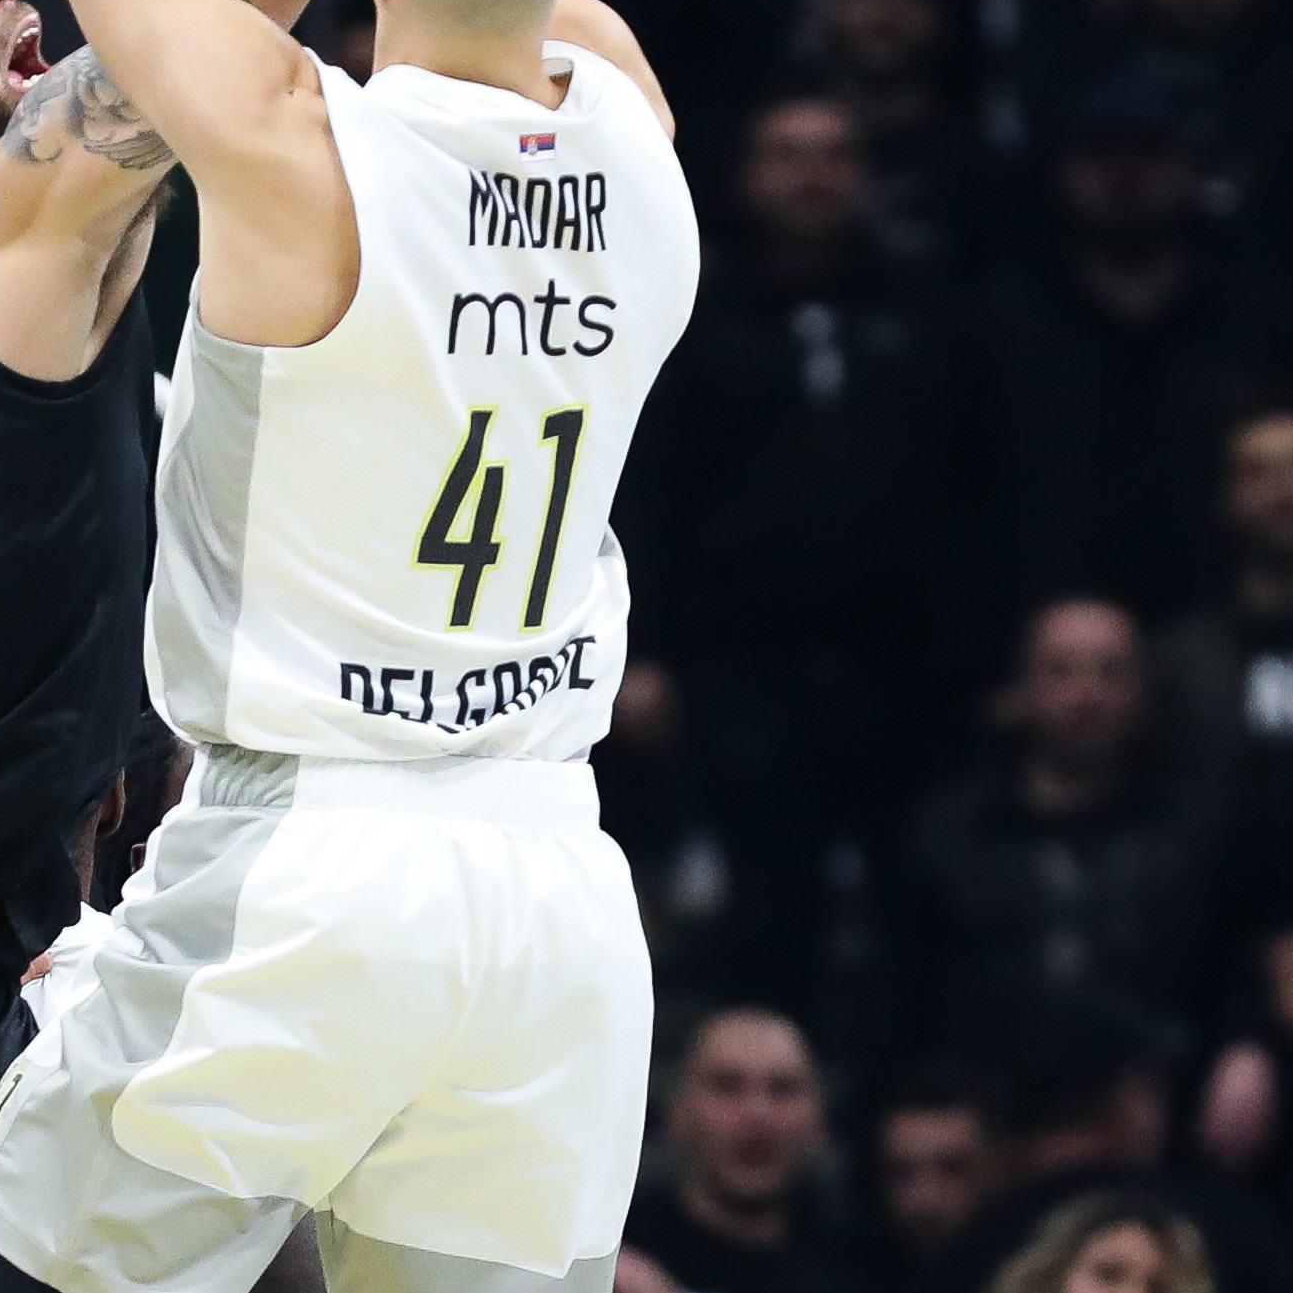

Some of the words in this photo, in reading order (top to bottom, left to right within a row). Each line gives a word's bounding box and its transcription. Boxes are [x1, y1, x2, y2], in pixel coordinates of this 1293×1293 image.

[468, 169, 607, 253] MADAR
[446, 278, 618, 357] mts
[410, 402, 590, 634] 41
